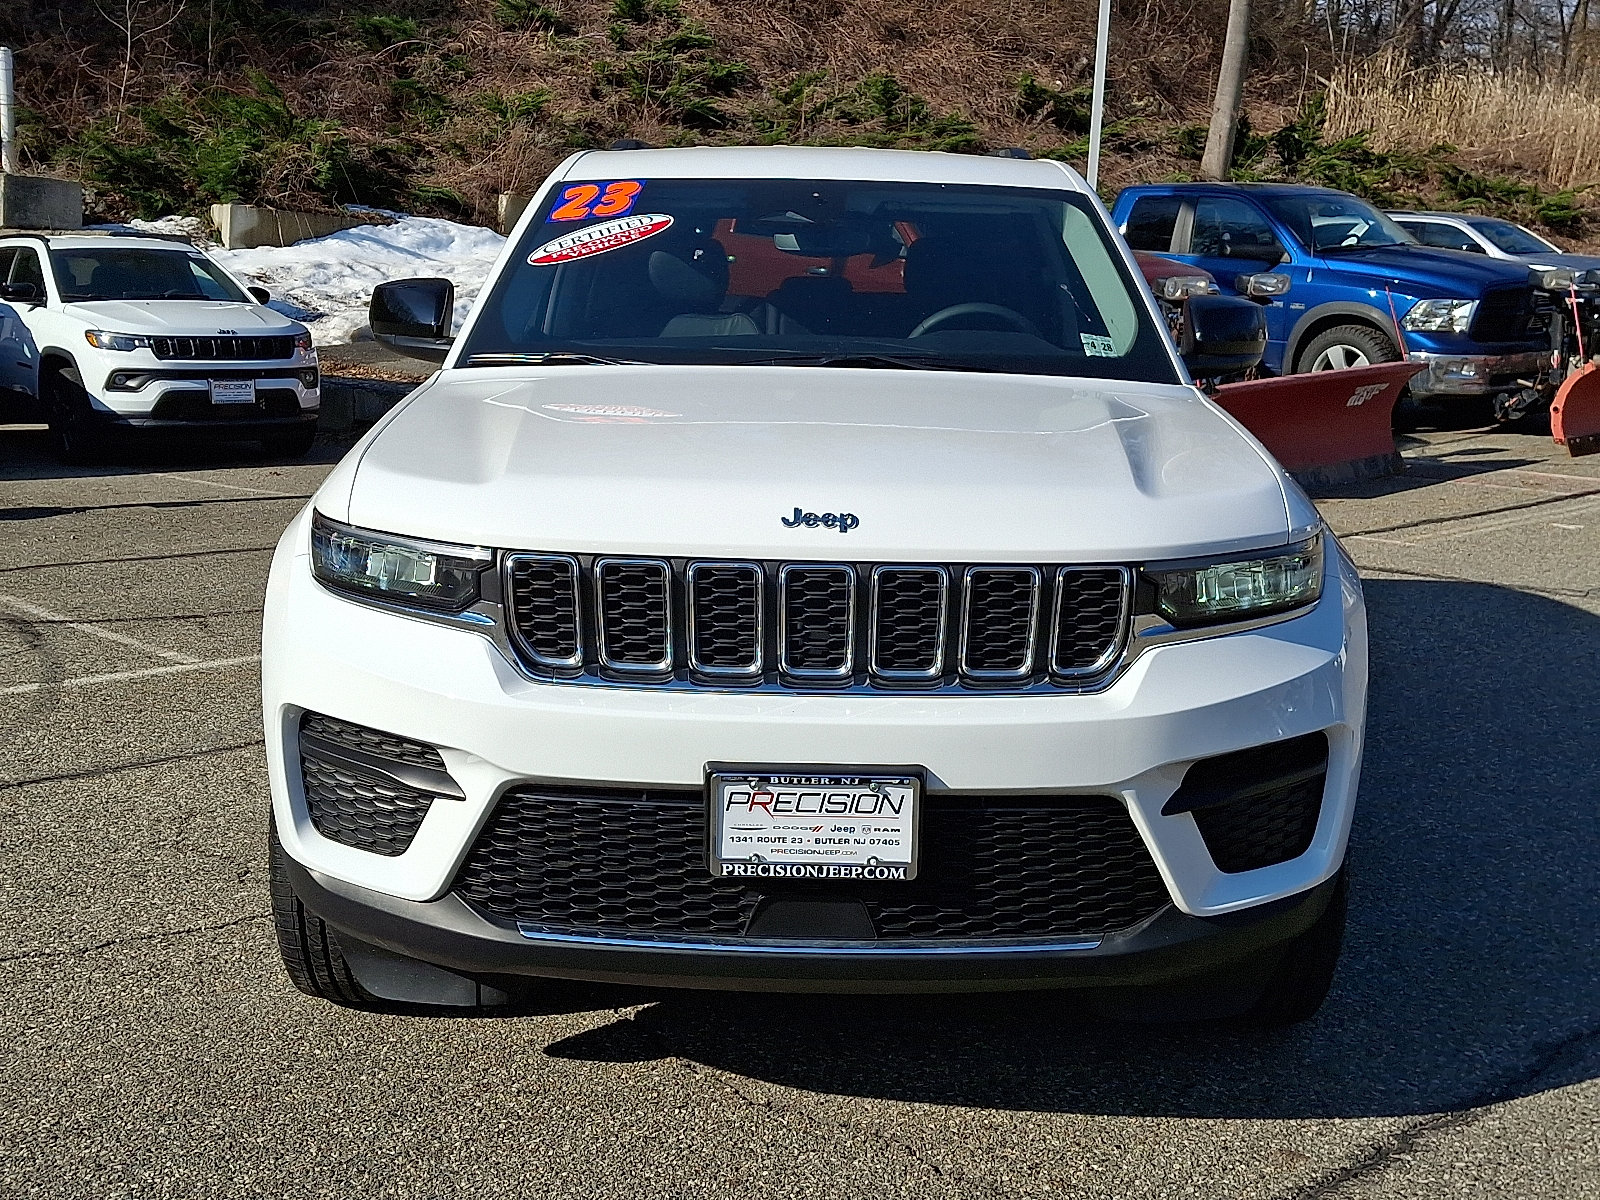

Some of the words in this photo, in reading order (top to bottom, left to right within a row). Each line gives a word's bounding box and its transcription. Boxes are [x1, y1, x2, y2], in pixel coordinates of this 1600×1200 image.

[551, 181, 643, 221] 23
[544, 214, 654, 253] CERTIFIED
[551, 225, 653, 259] PRE-OWNED
[568, 233, 642, 258] VEHICLE
[1100, 342, 1114, 352] 28
[781, 507, 860, 534] Jeep
[841, 777, 860, 785] NJ
[726, 792, 906, 819] PRECISION
[757, 836, 788, 844] ROUTE
[814, 837, 850, 845] BUTLER
[869, 838, 901, 846] 07405
[830, 824, 856, 835] Jeep
[721, 863, 907, 880] PRECISIONJEEP.COM
